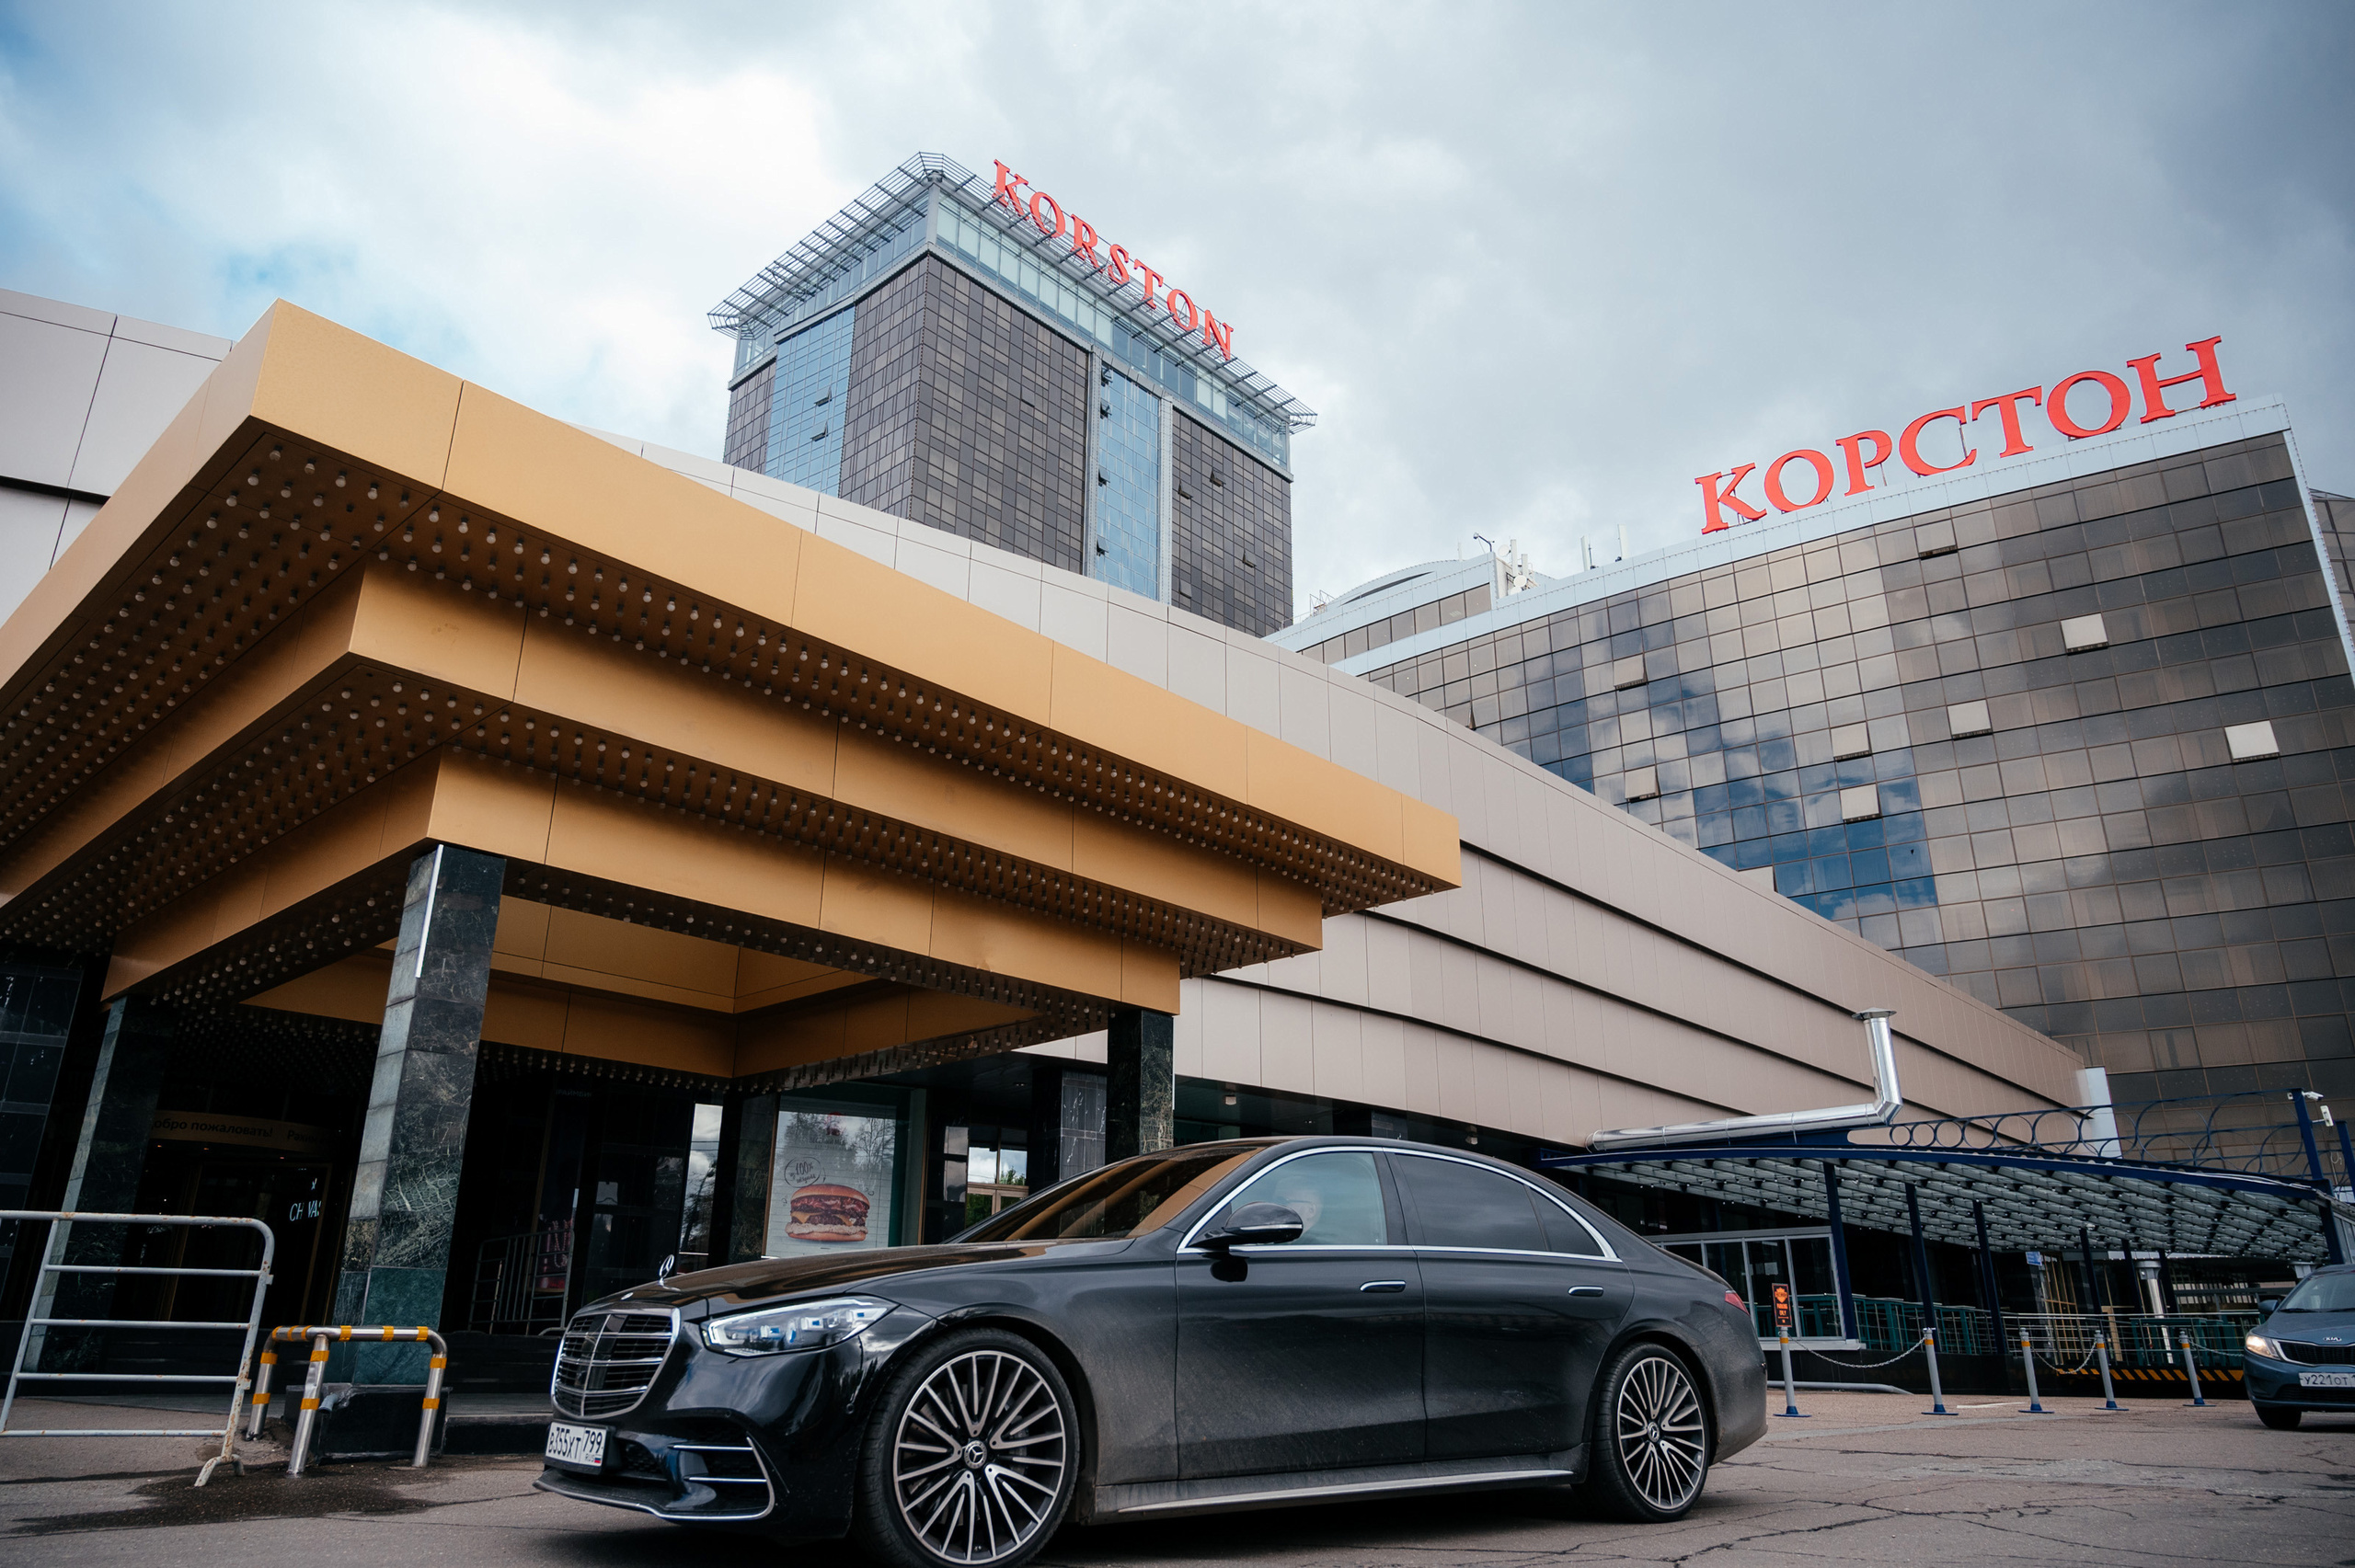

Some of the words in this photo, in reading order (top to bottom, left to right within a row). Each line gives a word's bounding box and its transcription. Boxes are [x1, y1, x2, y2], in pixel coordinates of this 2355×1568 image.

[992, 159, 1235, 361] KORSTON
[1694, 335, 2237, 534] КОРСТОН
[151, 1118, 188, 1131] обро
[190, 1120, 273, 1138] пожаловать!
